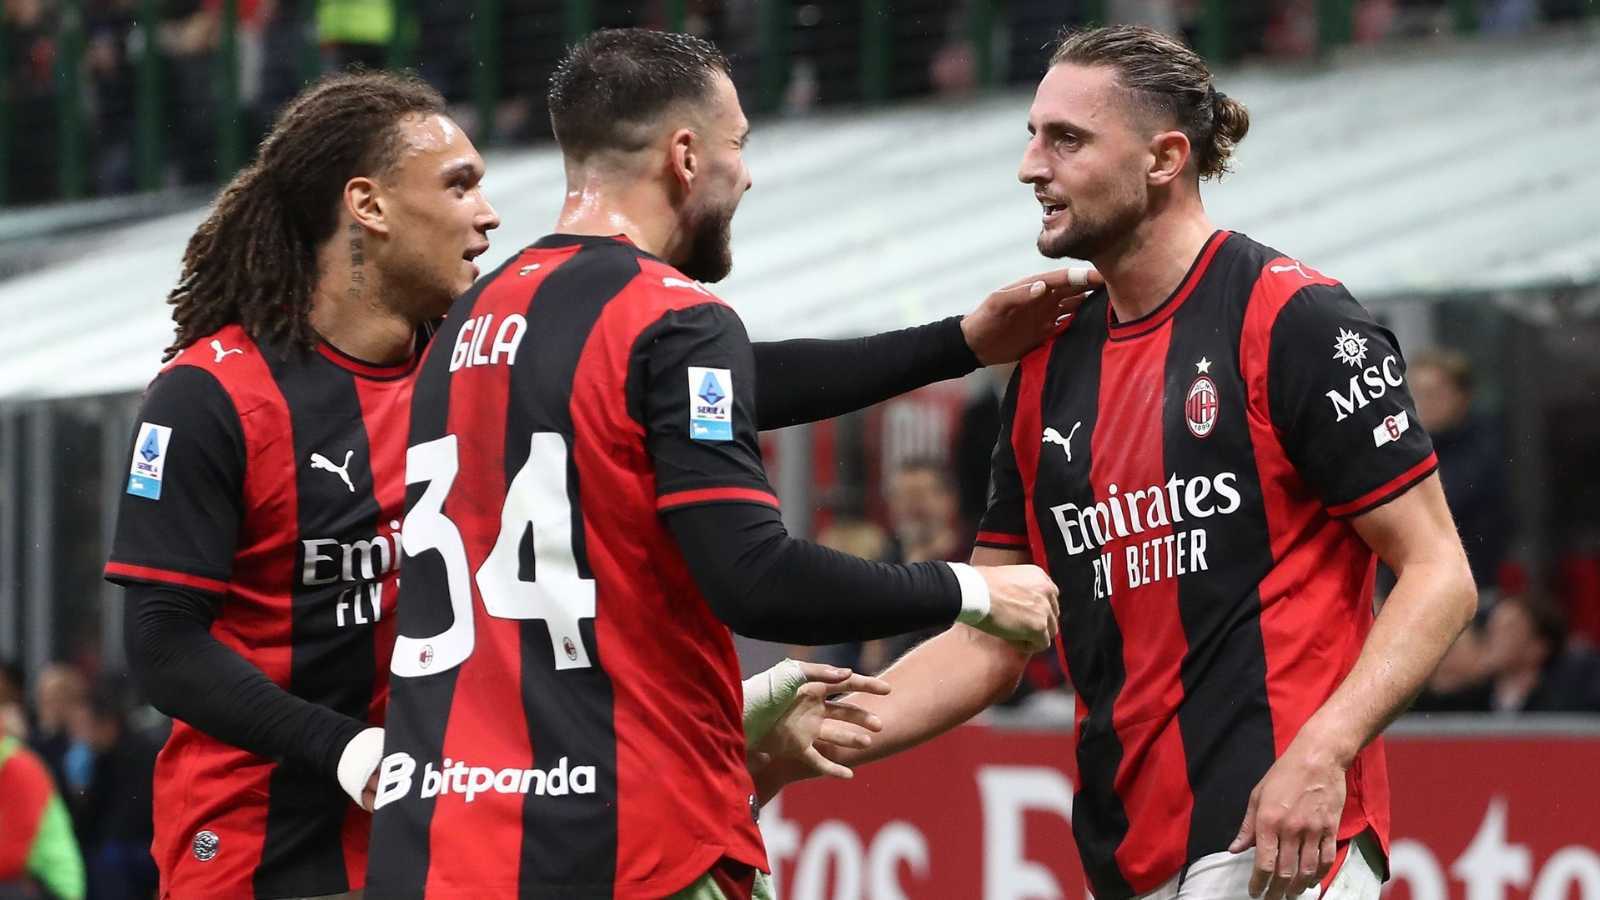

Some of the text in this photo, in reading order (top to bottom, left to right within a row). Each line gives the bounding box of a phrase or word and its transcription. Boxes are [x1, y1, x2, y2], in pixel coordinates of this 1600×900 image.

[449, 313, 528, 373] GILA
[697, 406, 717, 414] SERIE
[1325, 355, 1403, 422] MSC
[1050, 471, 1241, 556] Emirates
[390, 431, 596, 678] 34
[1125, 528, 1209, 589] BETTER
[420, 756, 596, 803] bitpanda
